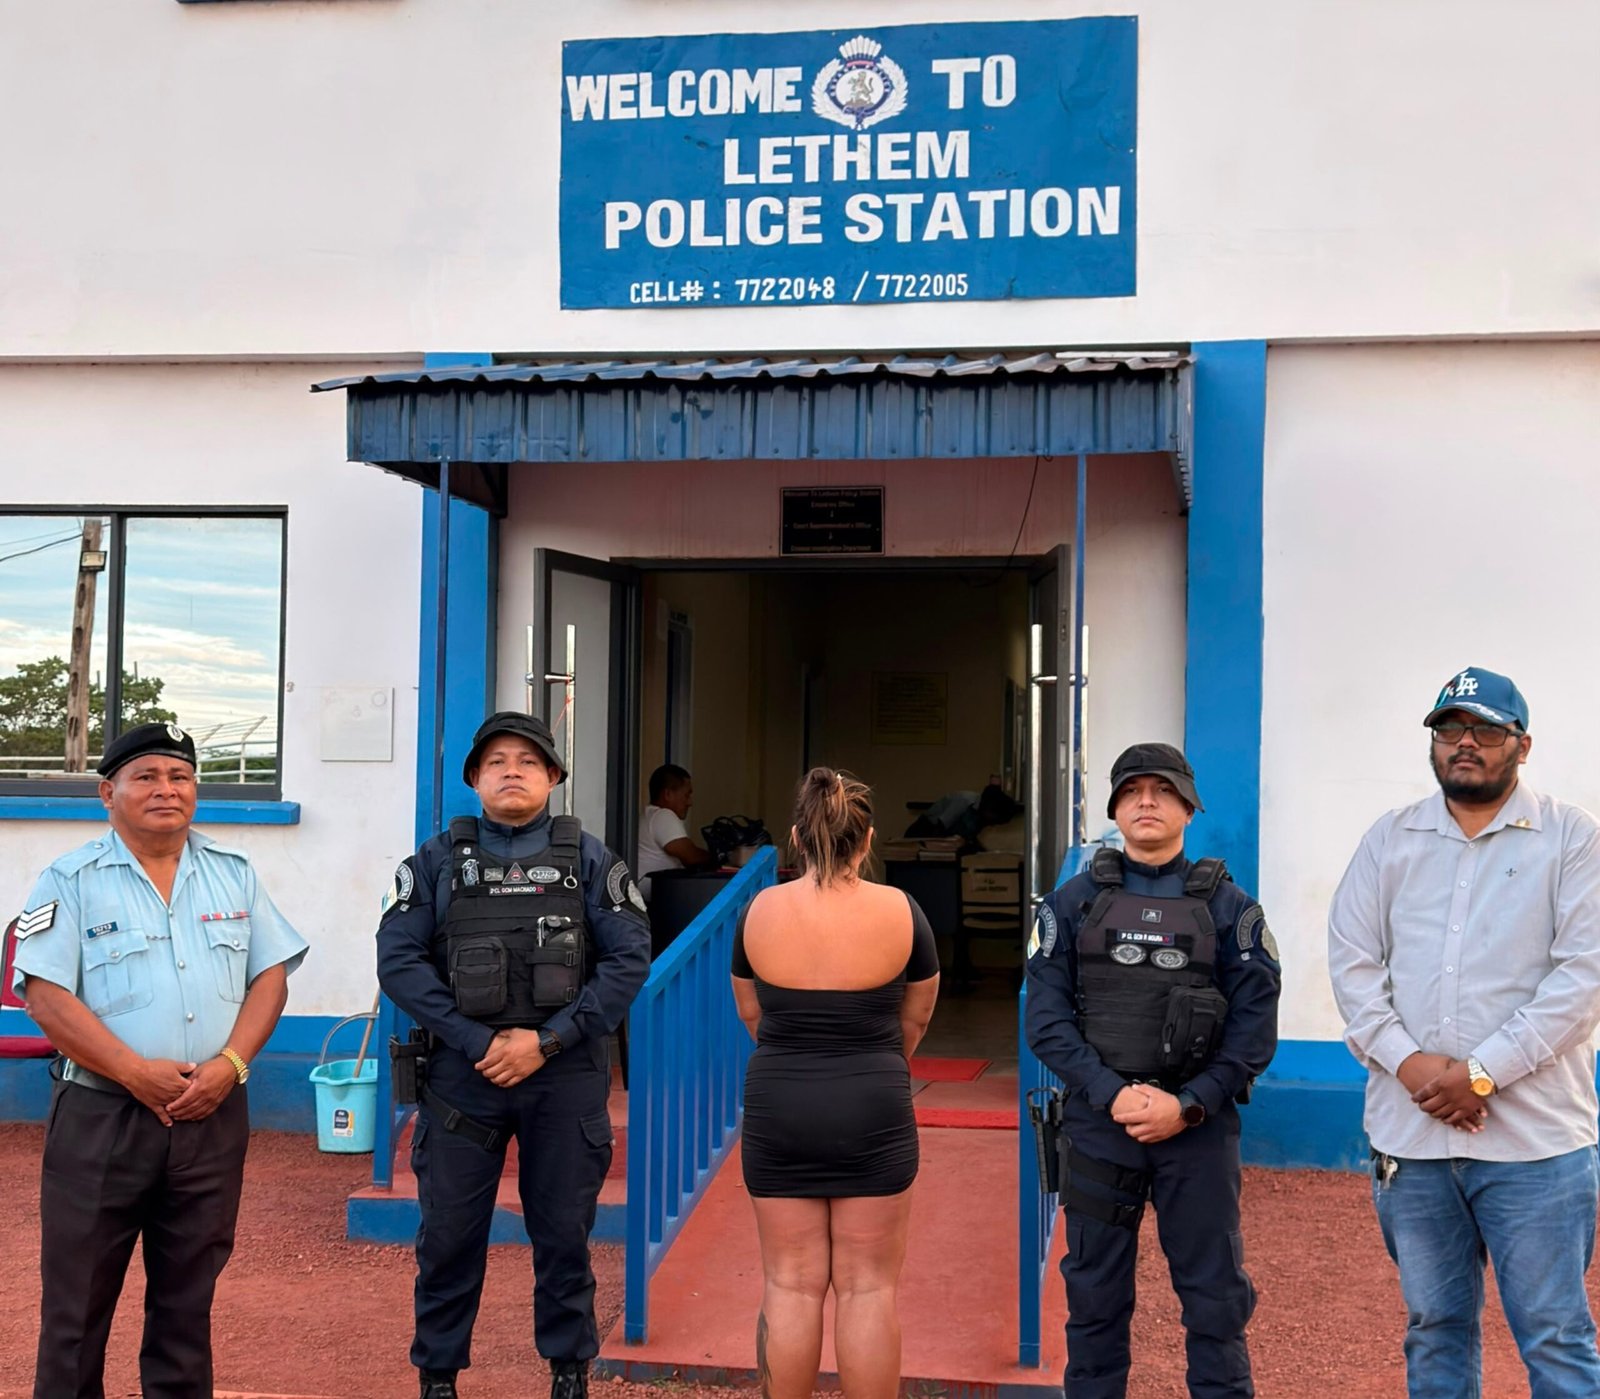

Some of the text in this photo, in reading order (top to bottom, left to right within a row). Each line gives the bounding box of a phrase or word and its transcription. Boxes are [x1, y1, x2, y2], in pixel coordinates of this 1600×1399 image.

[566, 55, 1016, 121] WELCOME TO
[724, 131, 970, 184] LETHEM
[605, 187, 1121, 249] POLICE STATION
[736, 277, 836, 301] 7722048
[1456, 672, 1479, 697] LA
